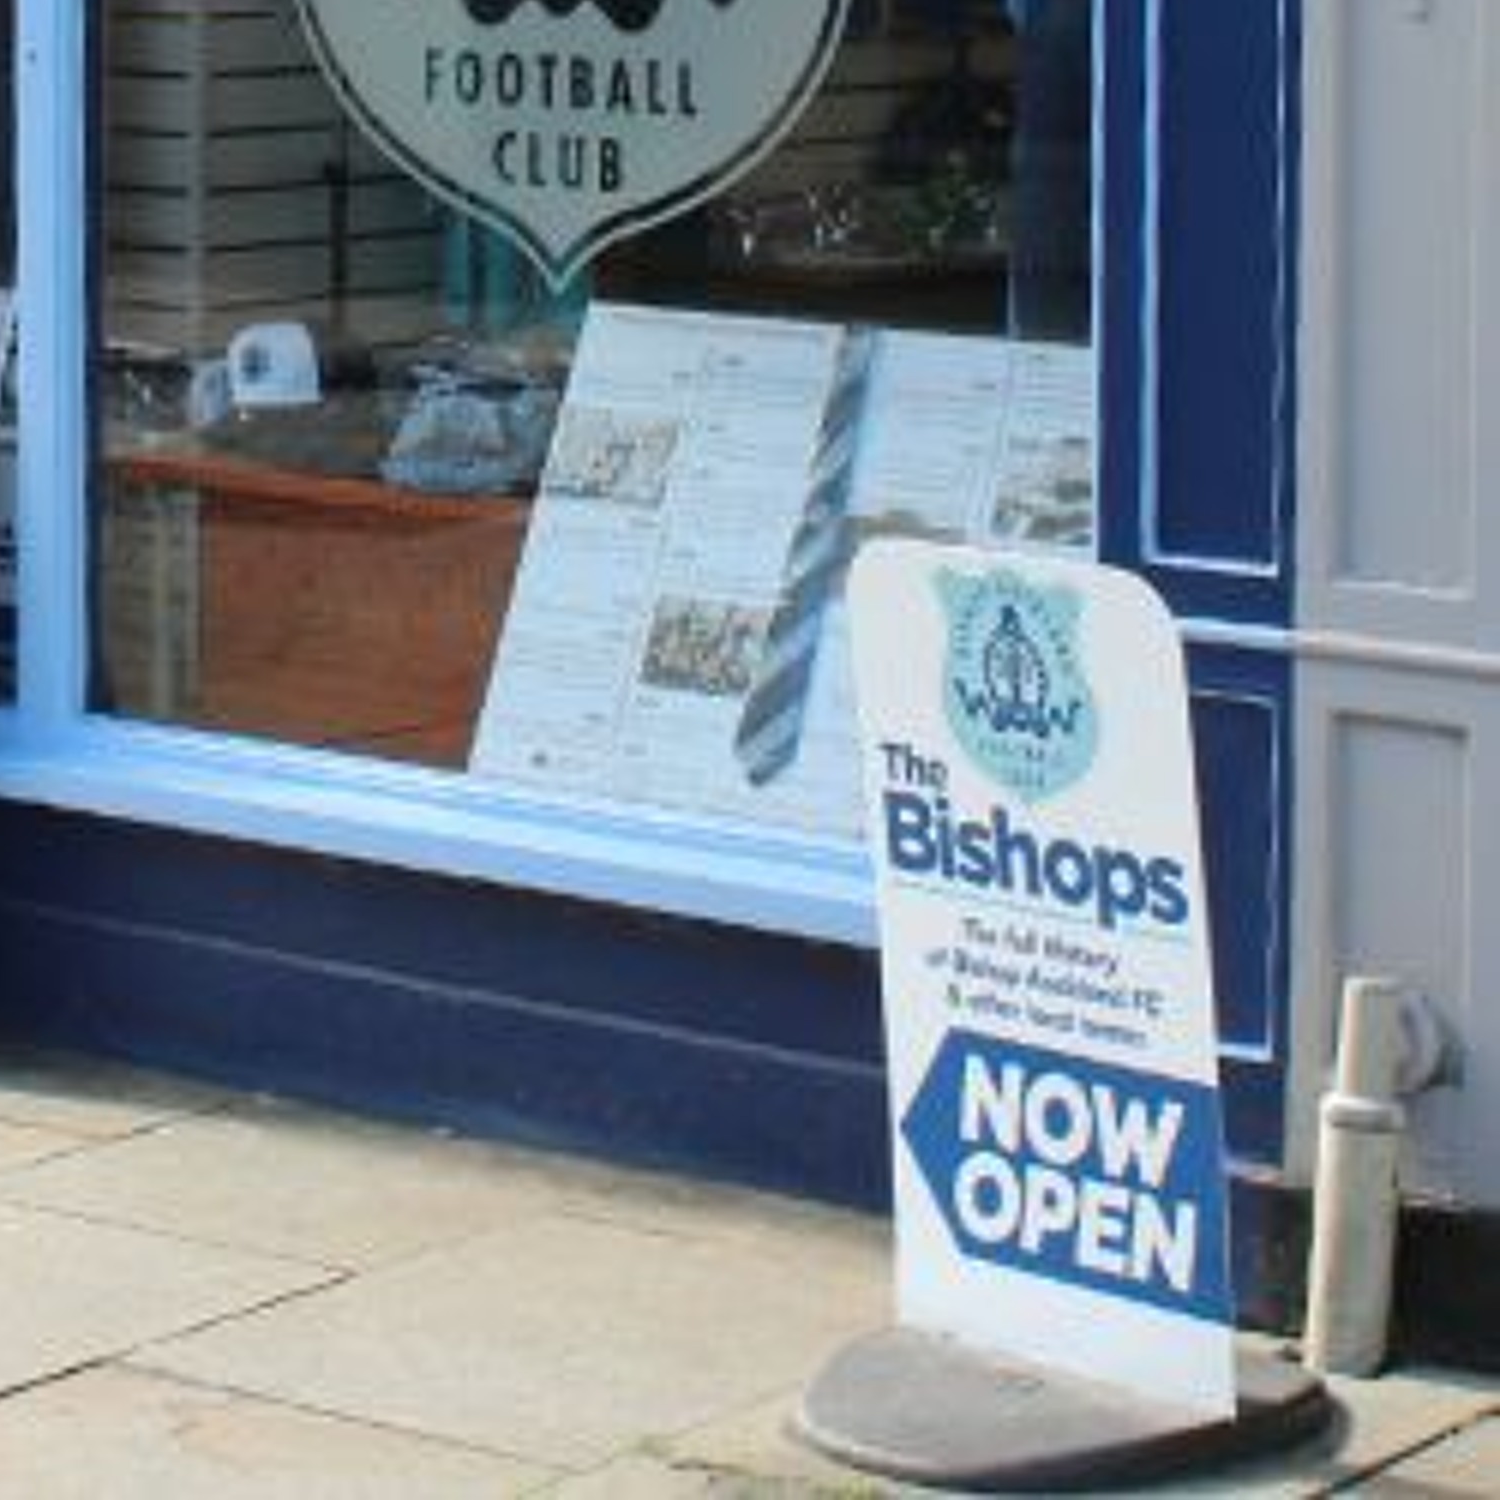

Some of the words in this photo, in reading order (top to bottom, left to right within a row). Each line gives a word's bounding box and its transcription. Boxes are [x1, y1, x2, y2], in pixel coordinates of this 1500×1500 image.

[423, 46, 700, 118] FOOTBALL
[491, 130, 622, 193] CLUB
[881, 742, 948, 790] The
[881, 790, 1190, 930] Bishops
[958, 1053, 1184, 1190] NOW
[951, 1148, 1198, 1294] OPEN
